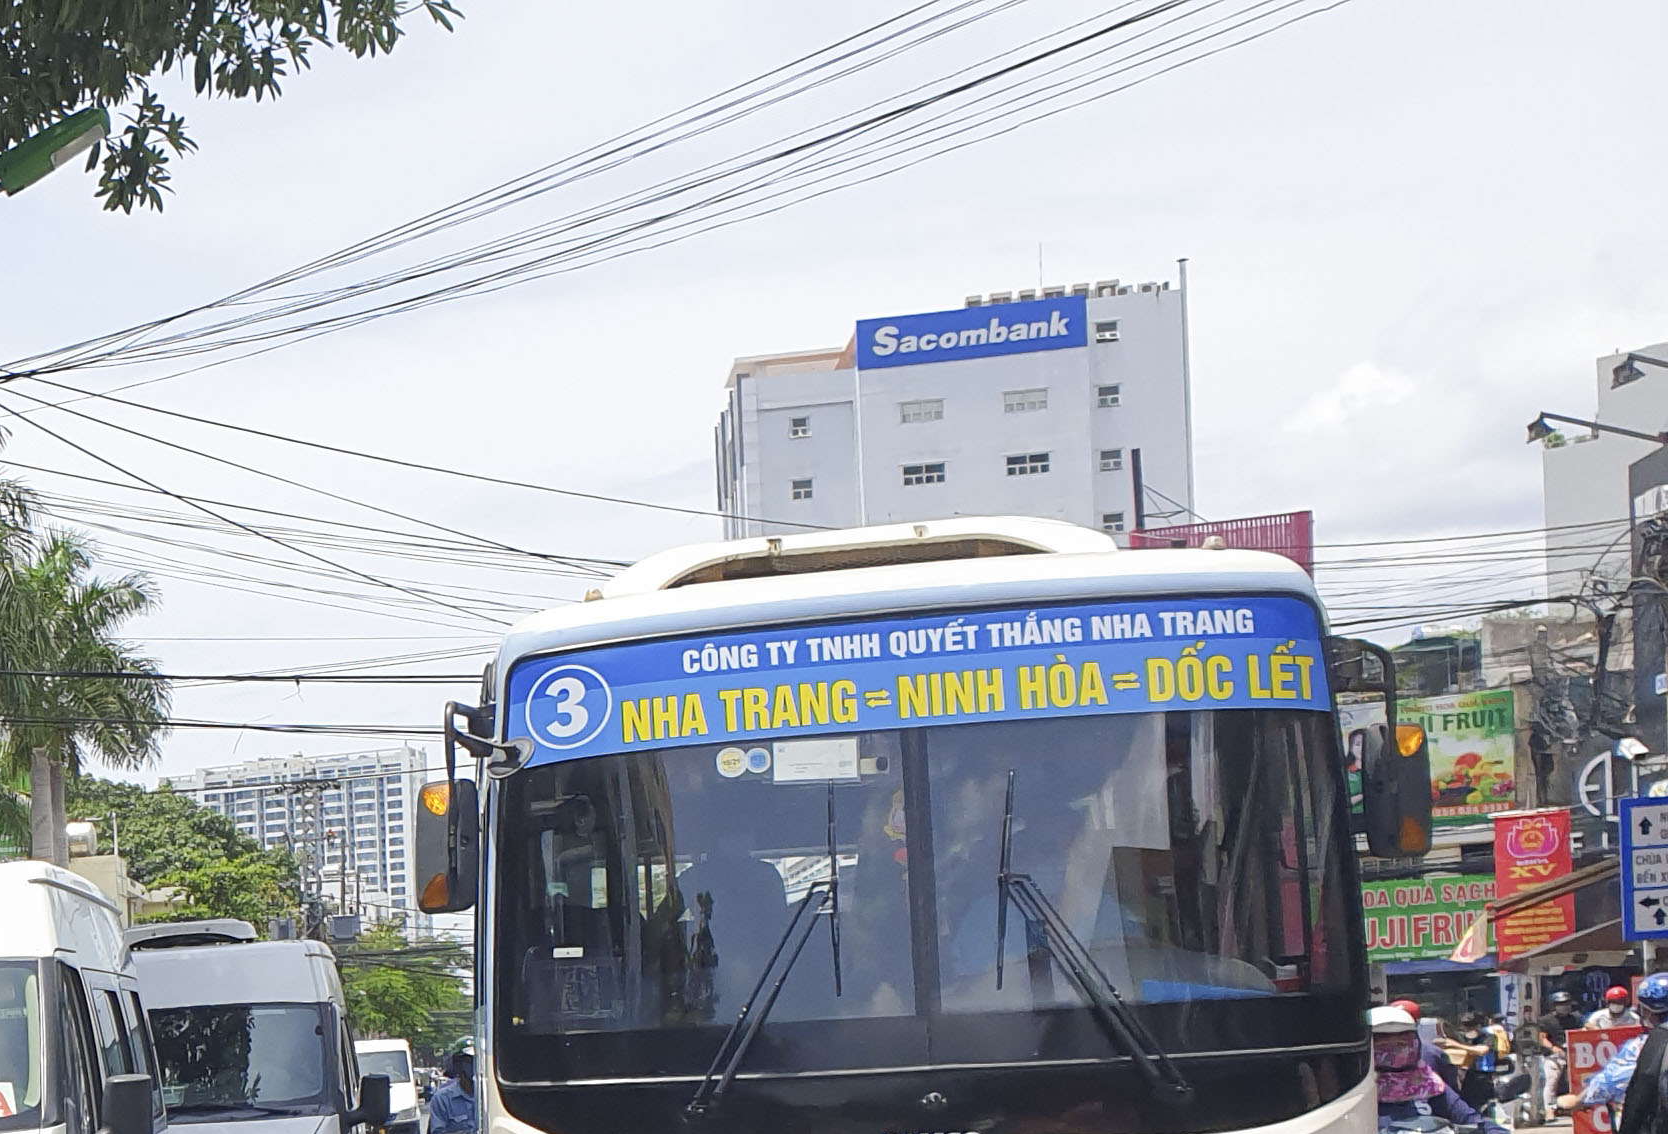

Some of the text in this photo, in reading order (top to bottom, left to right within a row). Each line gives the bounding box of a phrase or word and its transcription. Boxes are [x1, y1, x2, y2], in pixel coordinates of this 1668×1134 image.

[872, 310, 1070, 356] Sacombank
[682, 608, 1254, 674] CÔNG TY TNHH QUYẾT THẮNG NHA TRANG
[545, 677, 589, 738] 3
[621, 640, 1316, 744] NHA TRANG NINH HÒA DỐC LẾT
[1443, 708, 1508, 731] FRUIT
